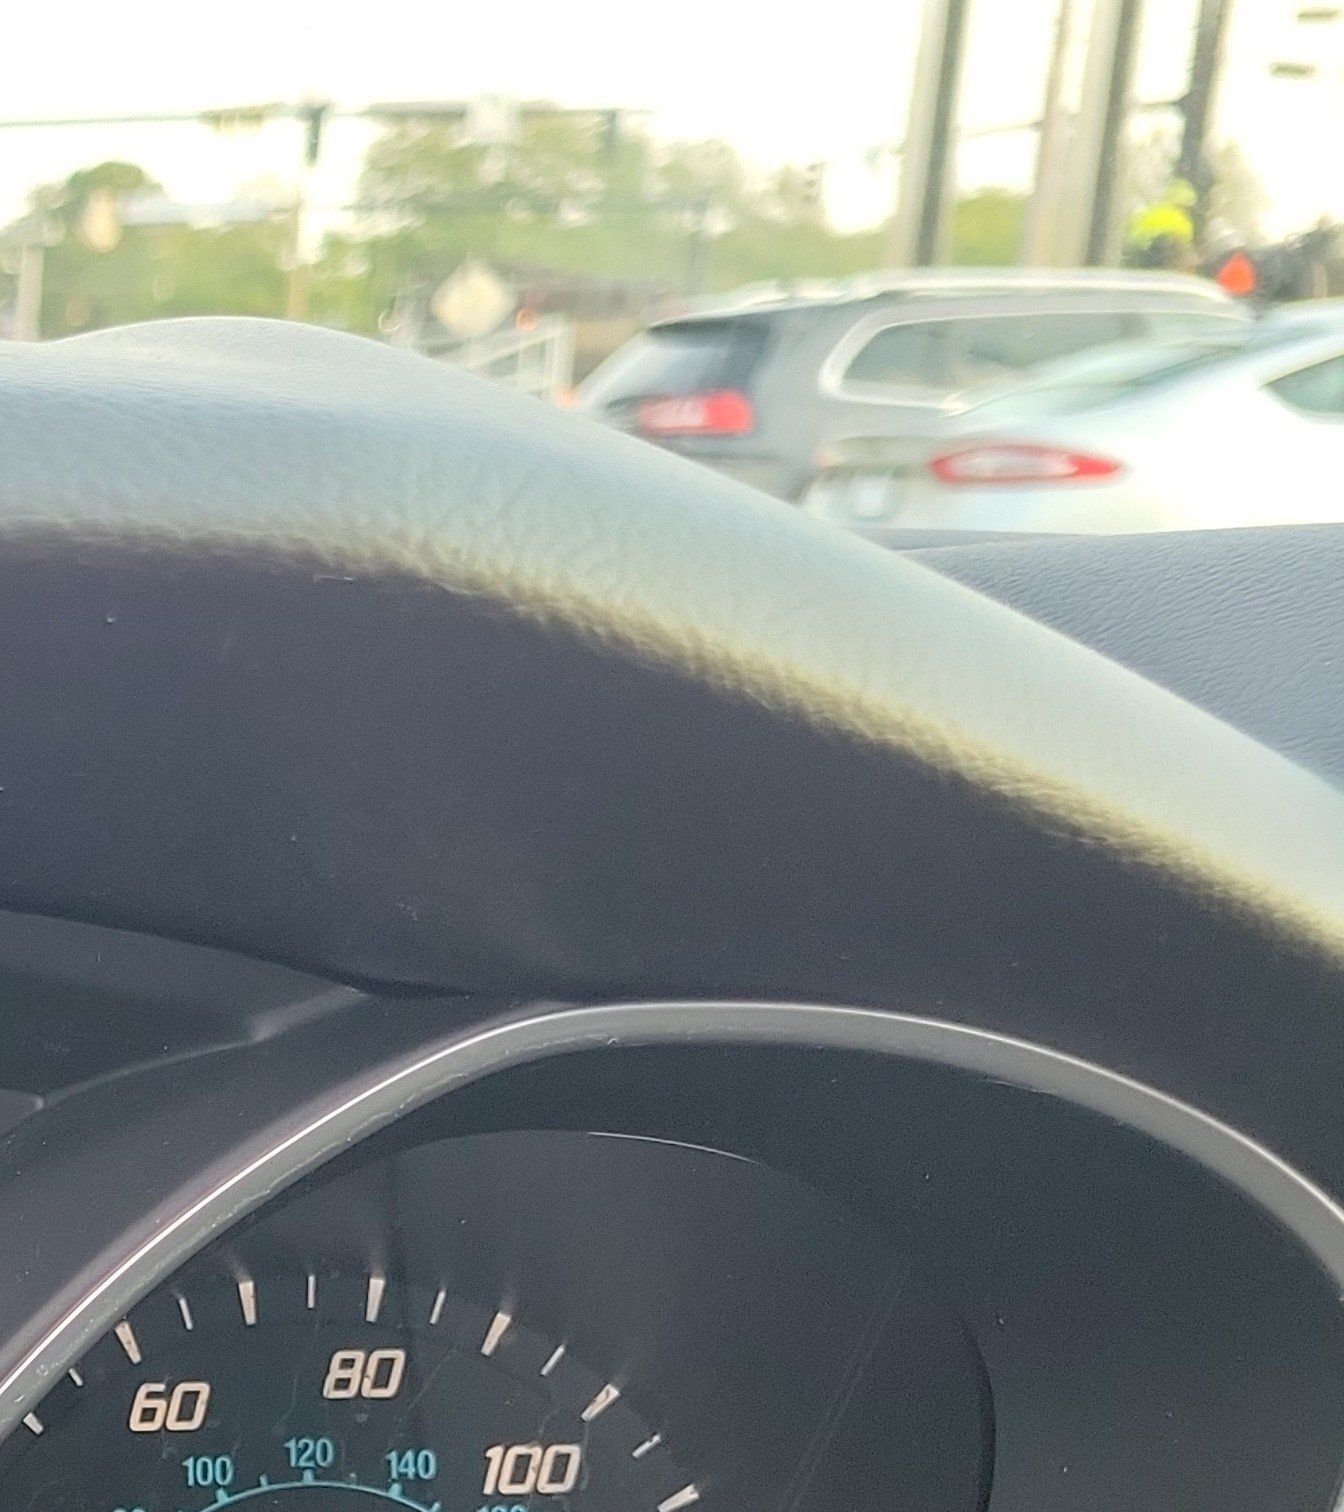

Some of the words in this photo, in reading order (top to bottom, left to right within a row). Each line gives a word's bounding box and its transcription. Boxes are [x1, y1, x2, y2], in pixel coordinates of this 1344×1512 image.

[323, 1350, 405, 1398] 80
[130, 1382, 210, 1431] 60
[183, 1456, 233, 1485] 100
[284, 1438, 333, 1467] 120
[386, 1450, 436, 1479] 140
[484, 1445, 580, 1494] 100
